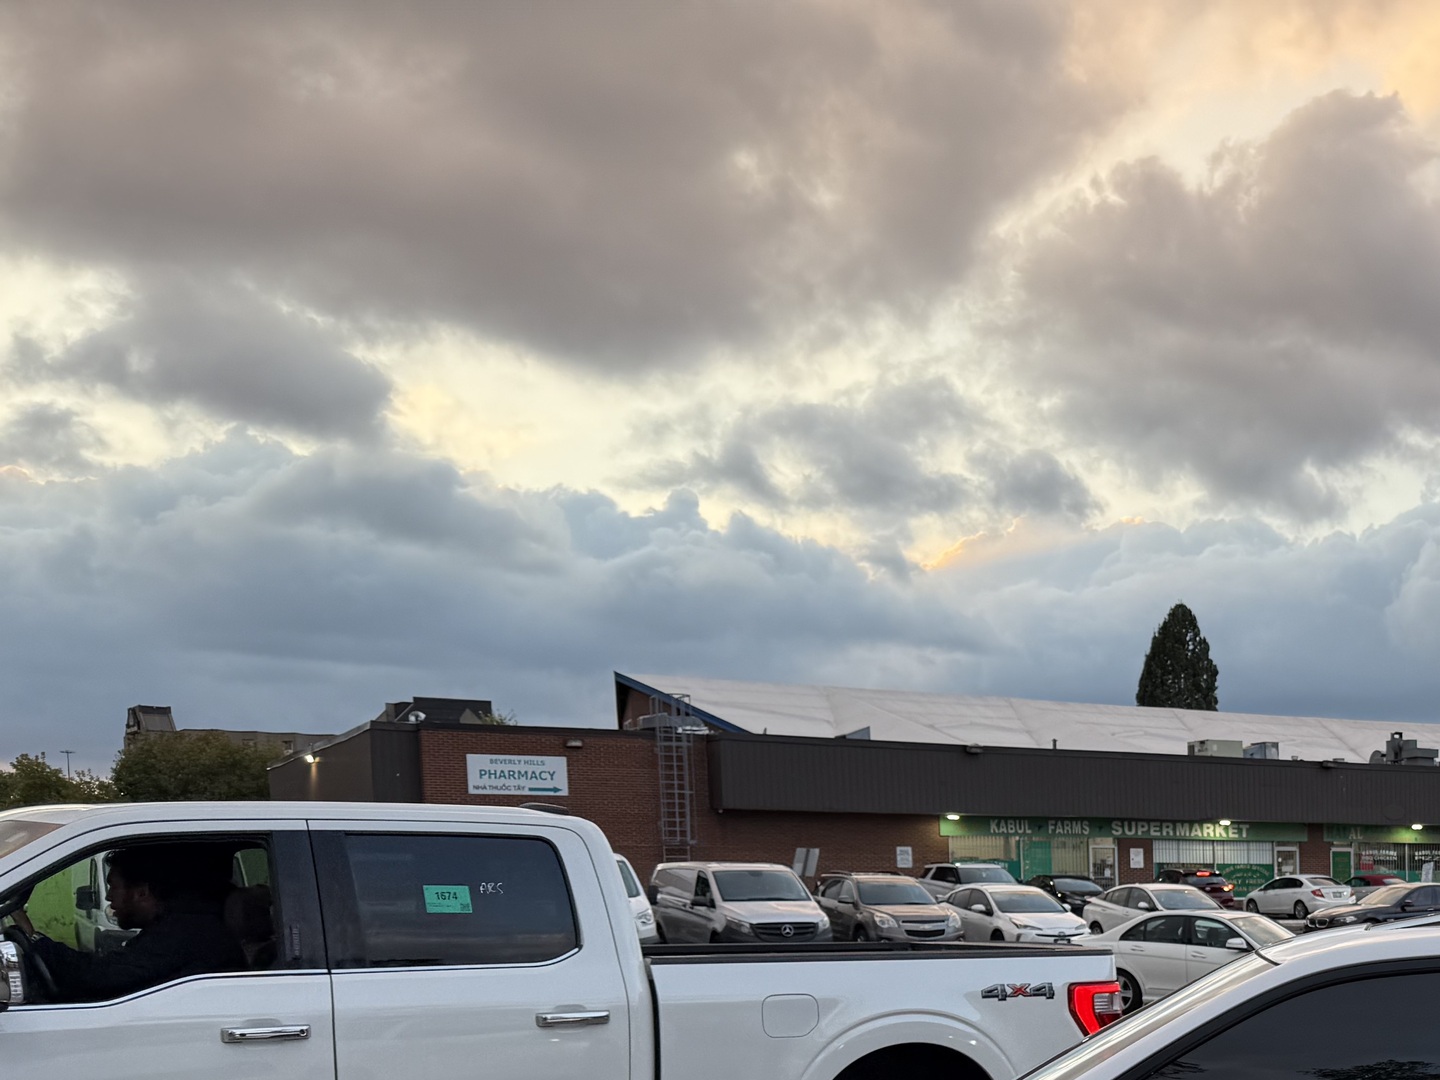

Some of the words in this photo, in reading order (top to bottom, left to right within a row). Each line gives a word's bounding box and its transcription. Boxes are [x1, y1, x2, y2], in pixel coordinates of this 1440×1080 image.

[489, 758, 521, 766] BEVERLY
[479, 769, 556, 781] PHARMACY
[990, 820, 1032, 834] KABUL
[1048, 821, 1090, 835] FARMS
[1111, 821, 1249, 838] SUPERMARKET
[435, 891, 458, 900] 1674
